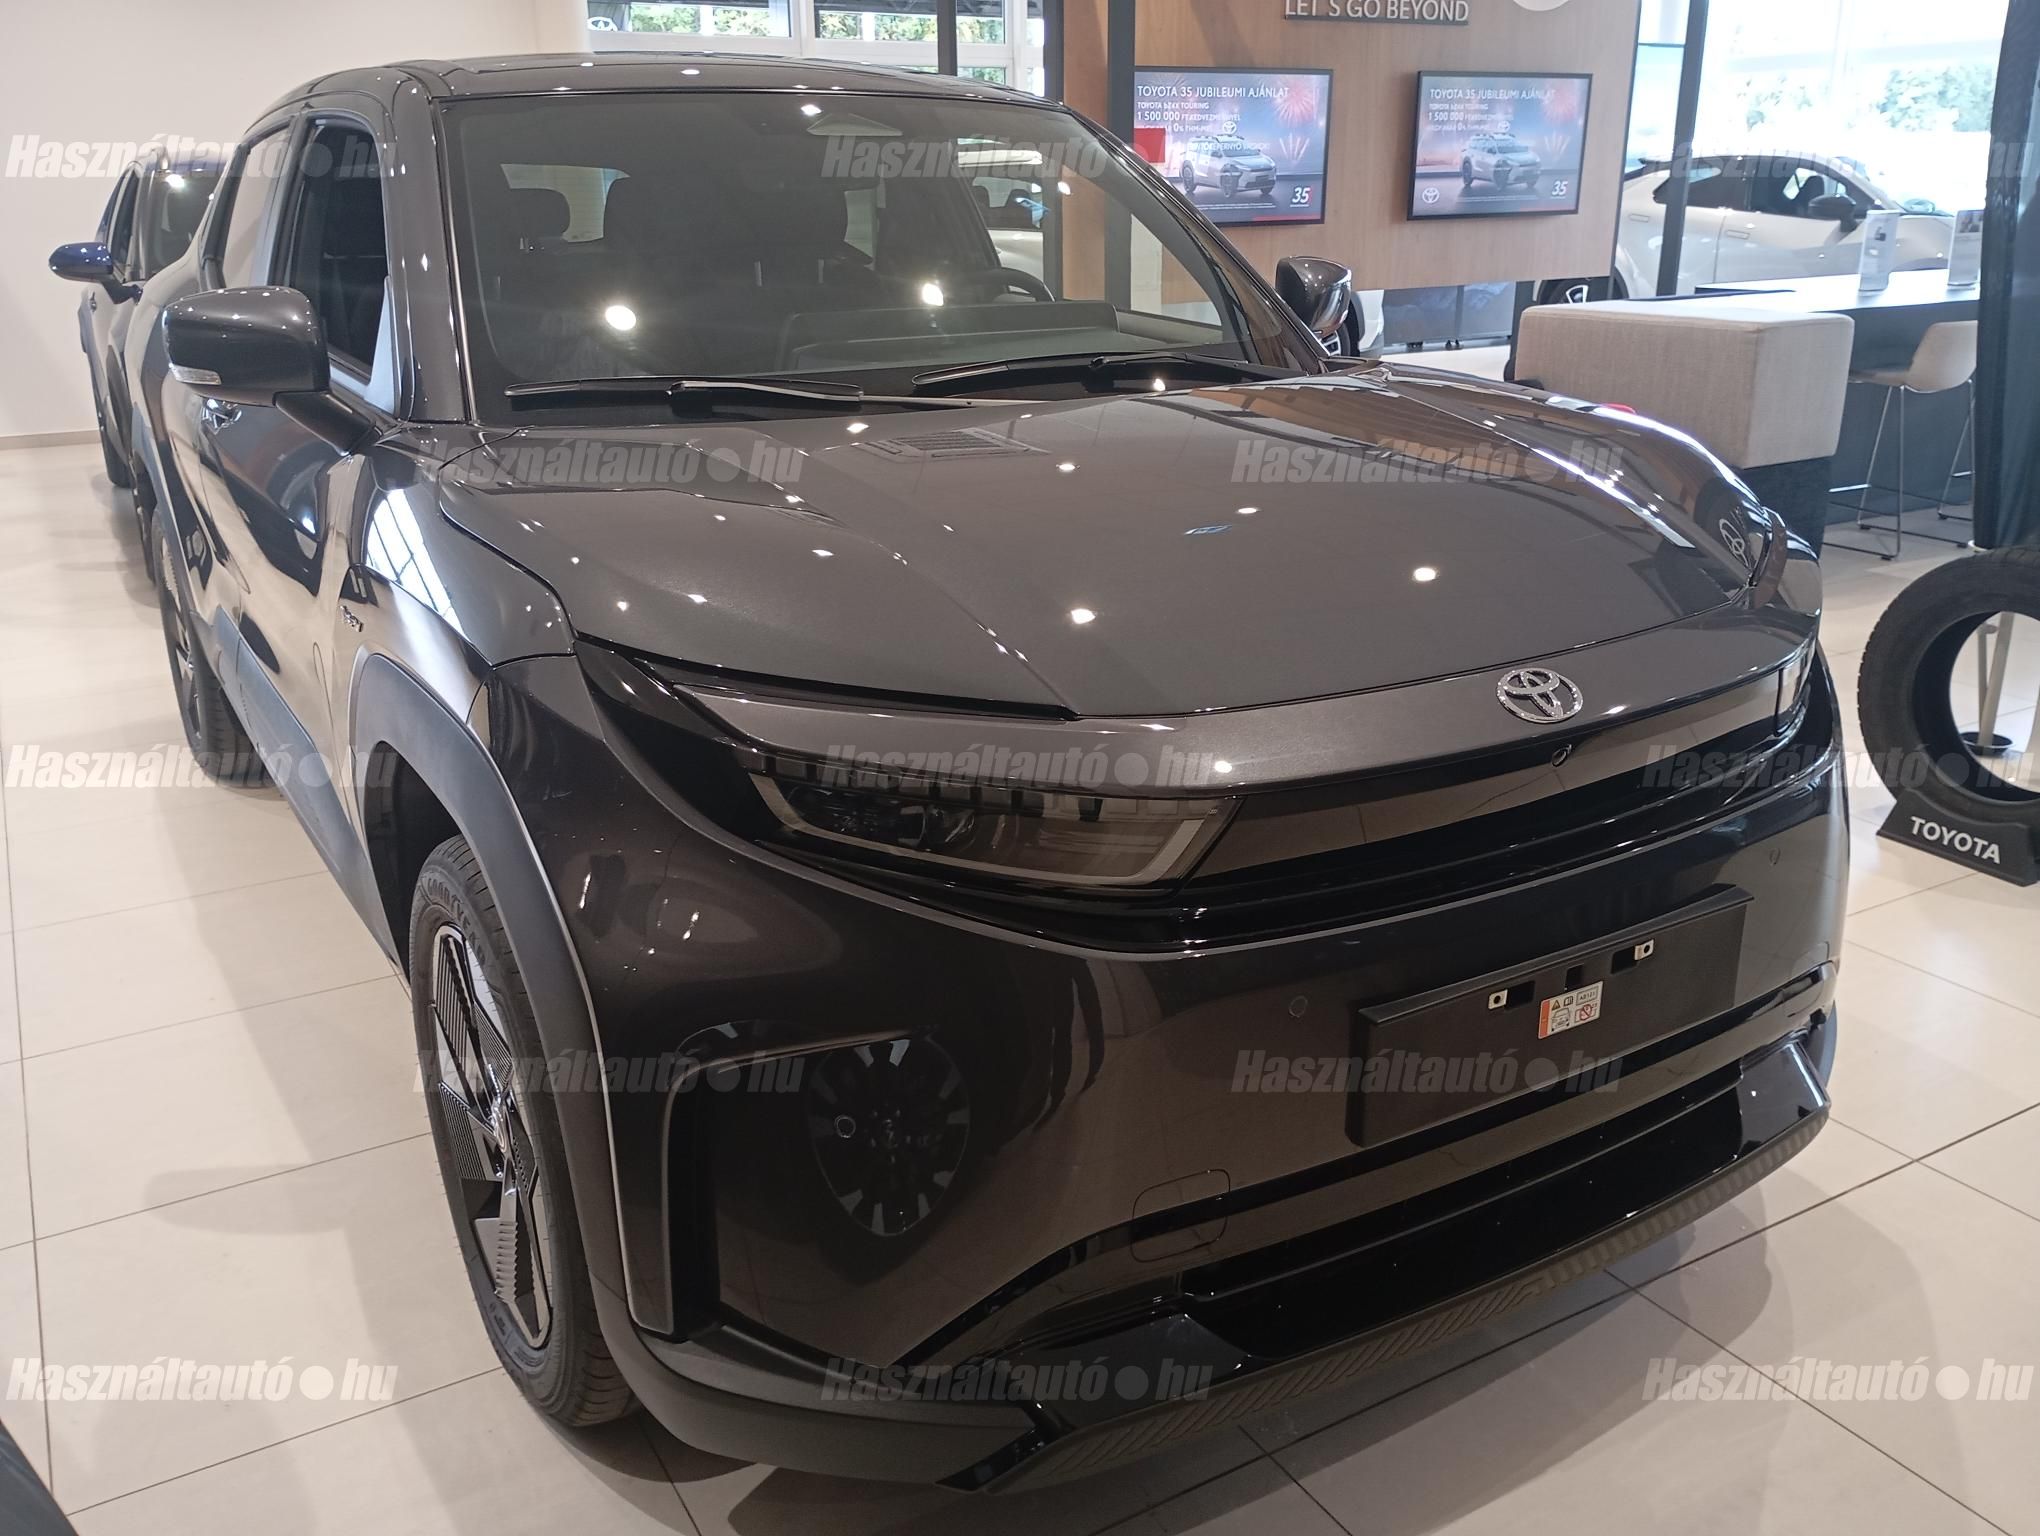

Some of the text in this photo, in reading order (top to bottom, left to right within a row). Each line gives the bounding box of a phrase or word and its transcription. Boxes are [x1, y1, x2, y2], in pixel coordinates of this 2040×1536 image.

[1285, 0, 1469, 22] LETS GO BEYOND
[1137, 83, 1290, 98] TOYOTA 35 JUBILEUMI AJÁNLAT
[1429, 88, 1464, 99] TOYOTA
[1465, 88, 1475, 99] 35
[1477, 88, 1519, 100] JUBILEUMI
[1143, 111, 1161, 121] 500
[1163, 112, 1180, 121] 000
[1434, 112, 1449, 121] 500
[1450, 112, 1464, 121] 000
[1291, 186, 1311, 204] 35
[1551, 180, 1568, 196] 35
[1911, 816, 2001, 864] TOYOTA
